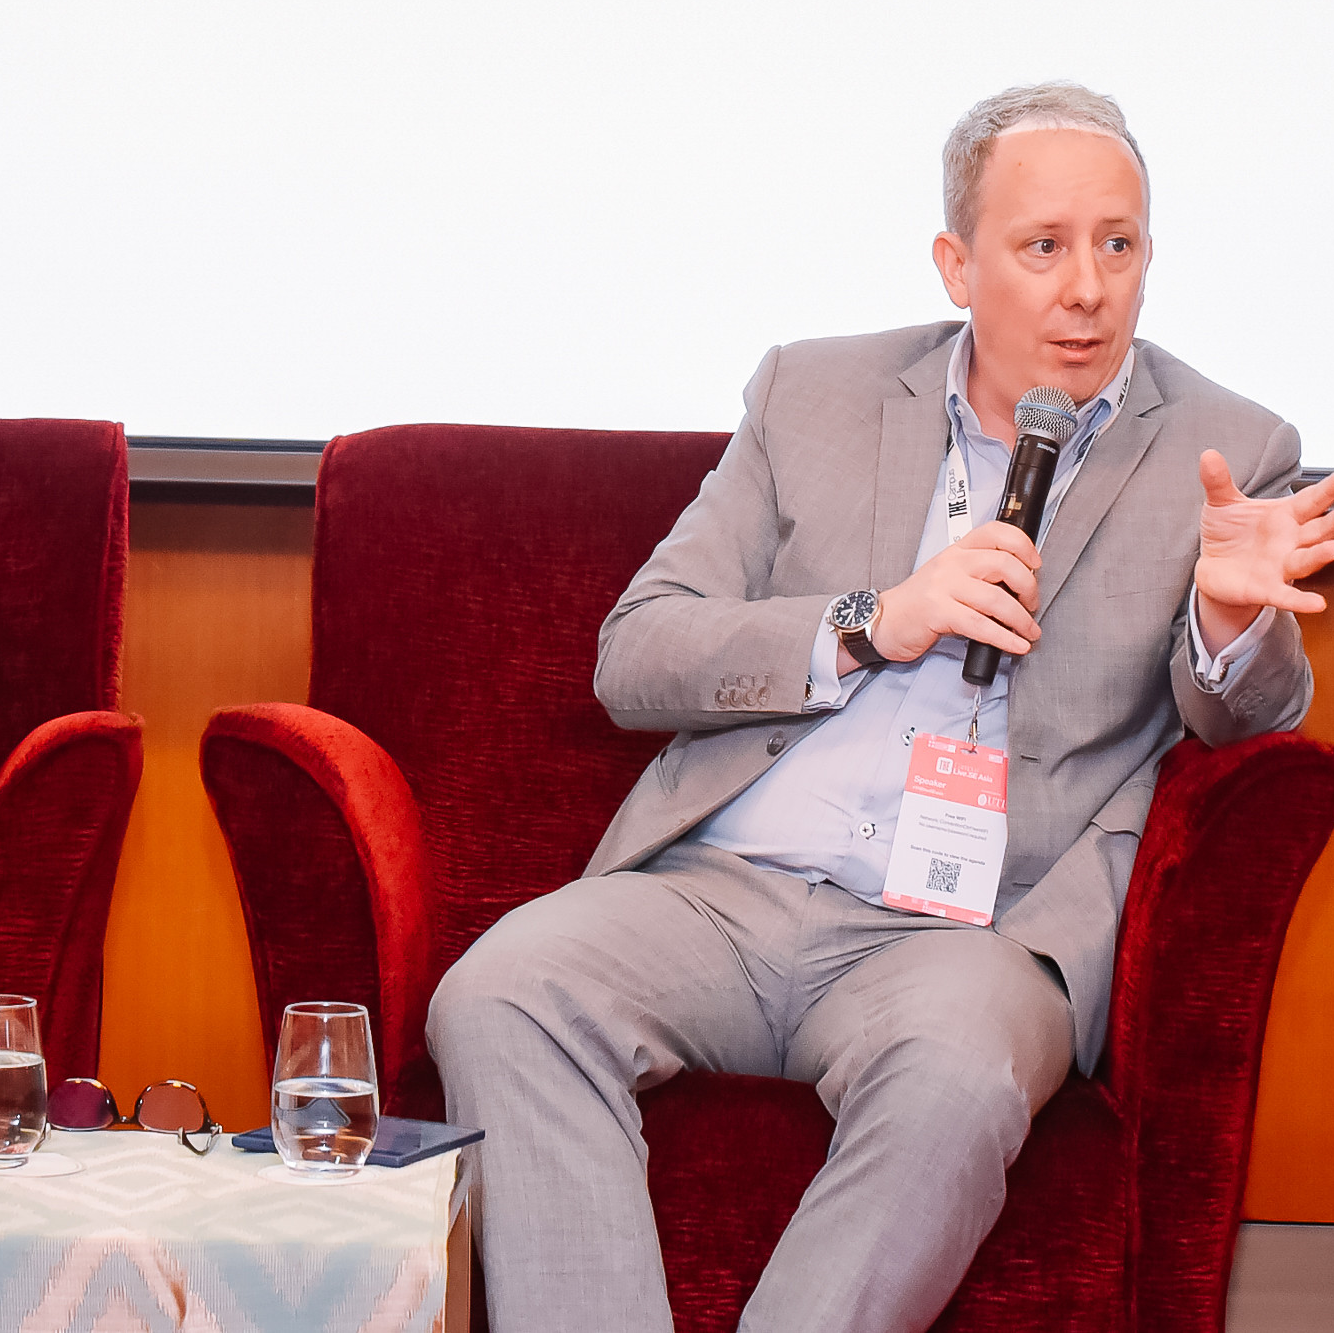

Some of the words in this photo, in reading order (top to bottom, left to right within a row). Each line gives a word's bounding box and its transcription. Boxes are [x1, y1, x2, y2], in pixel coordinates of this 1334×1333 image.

[956, 479, 966, 499] Live
[948, 499, 968, 519] THE
[914, 775, 947, 788] Speaker
